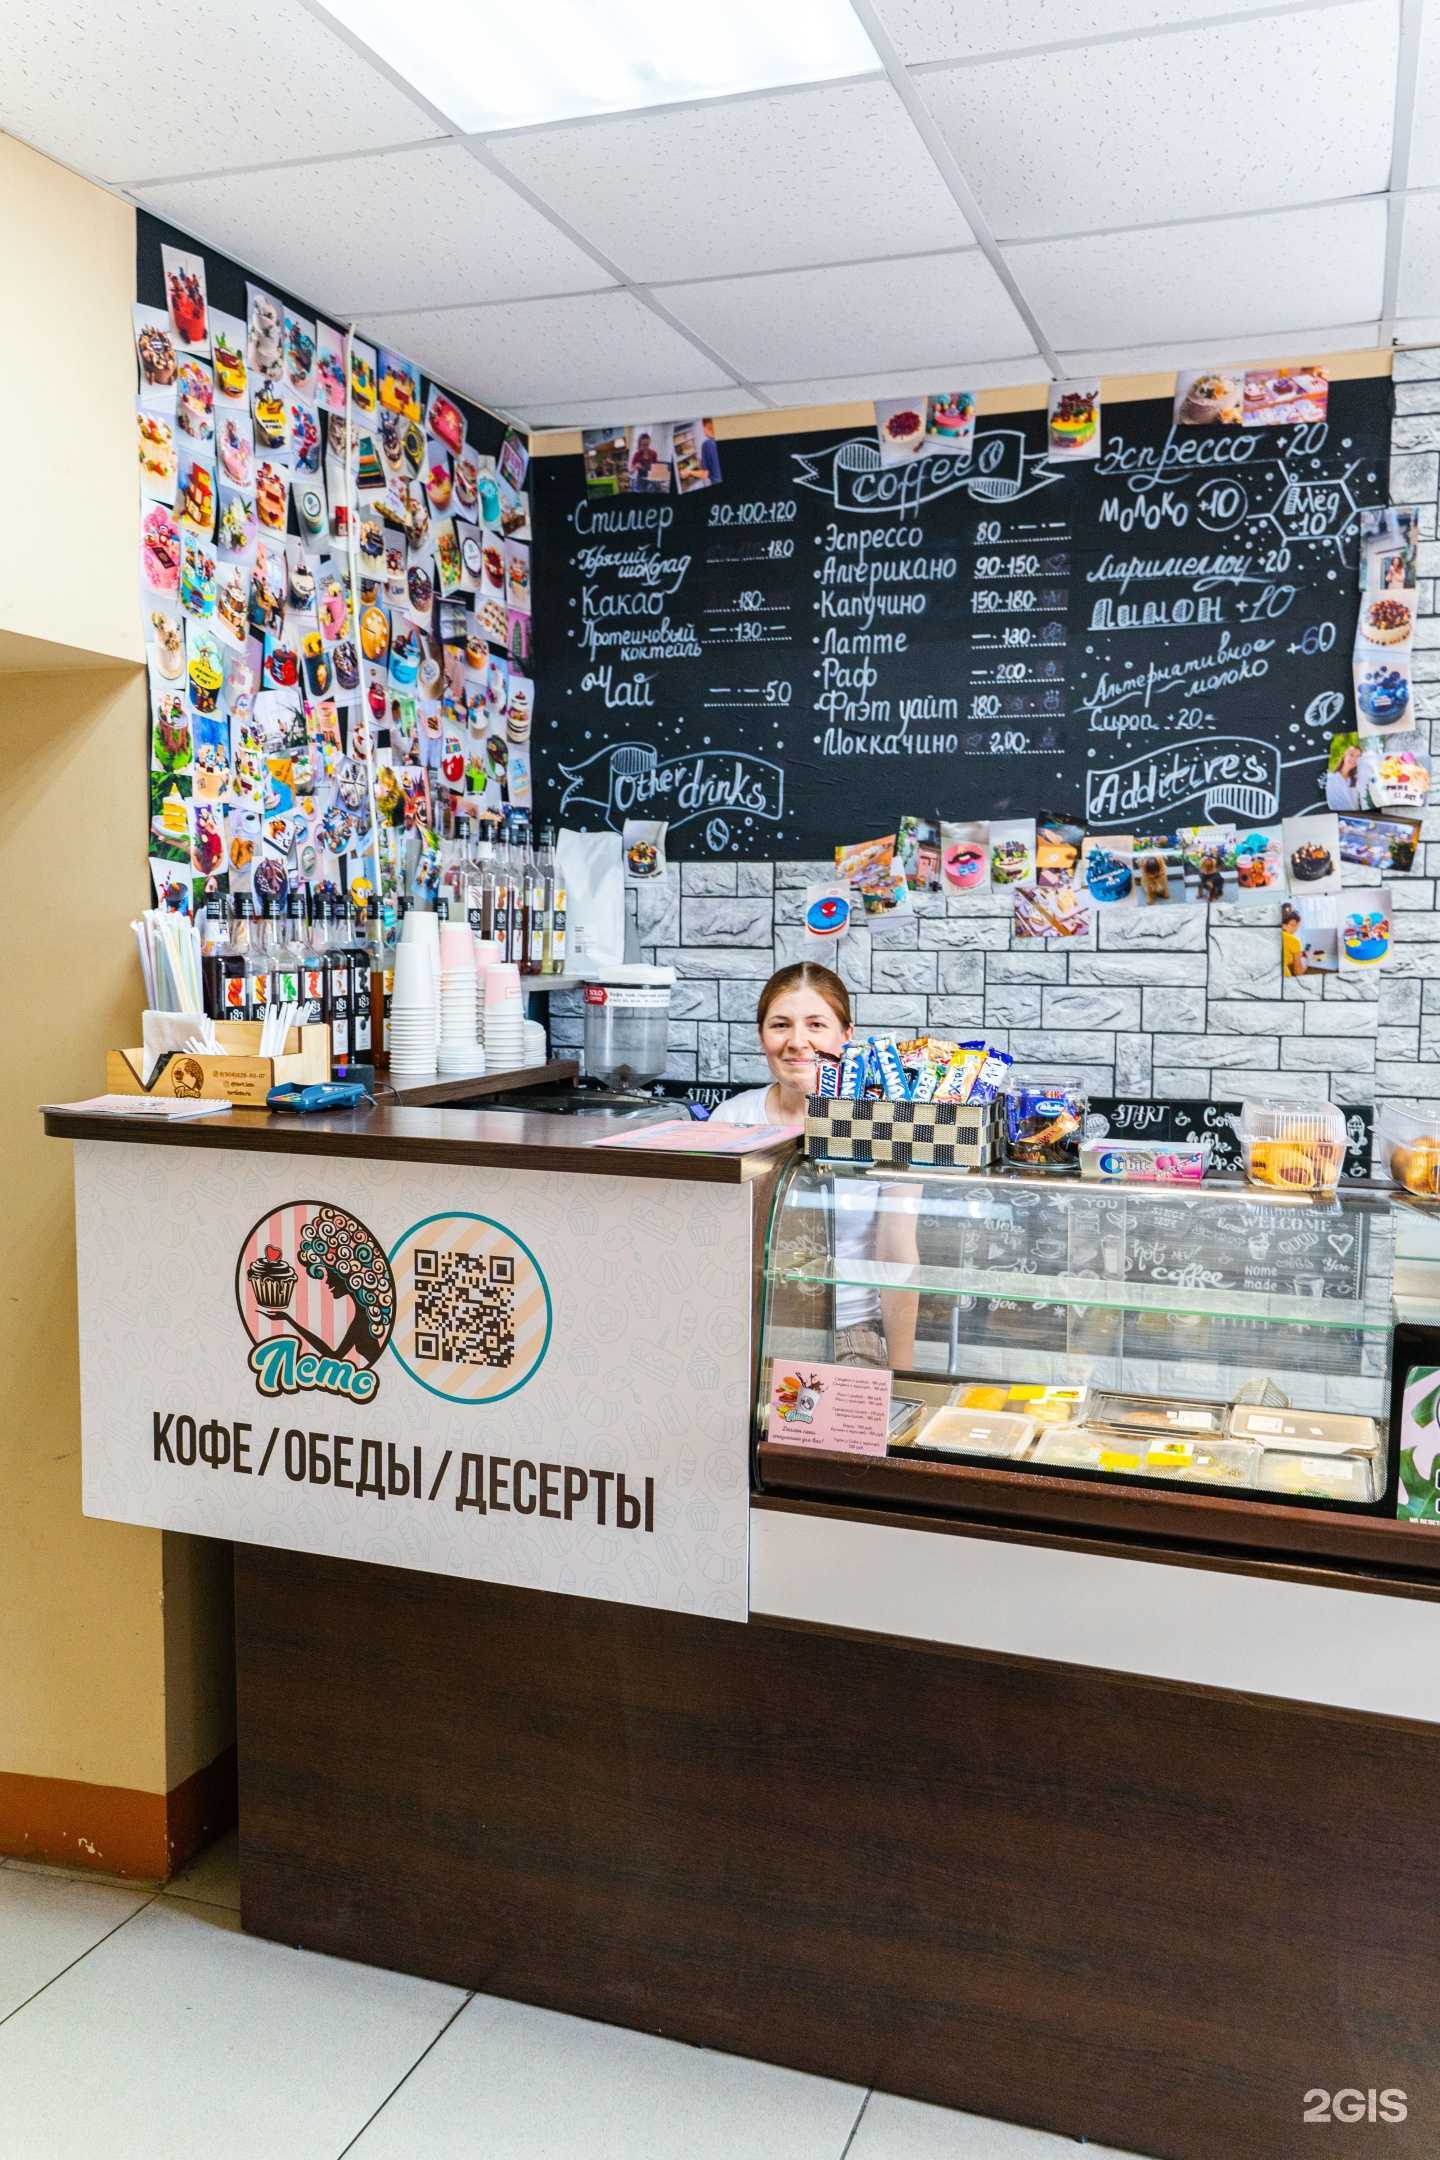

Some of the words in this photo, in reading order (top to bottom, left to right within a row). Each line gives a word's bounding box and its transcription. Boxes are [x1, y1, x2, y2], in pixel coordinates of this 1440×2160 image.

[1095, 426, 1262, 492] Эспрессо
[1100, 491, 1188, 532] Молоко
[825, 523, 923, 563] Эспрессо
[976, 521, 1001, 543] 80
[820, 556, 957, 598] Американо
[582, 585, 664, 616] Какао
[820, 590, 926, 630] Капучино
[621, 643, 702, 661] коктейль
[820, 627, 908, 654] Латте
[581, 665, 658, 708] Чай
[822, 656, 878, 700] Раф
[996, 663, 1026, 681] 200
[1184, 659, 1269, 698] молоко
[818, 689, 890, 723] Флэт
[1090, 707, 1155, 740] Сироп
[822, 727, 958, 755] Моккачино
[614, 766, 687, 812] Other
[678, 759, 766, 812] drinks
[1089, 753, 1268, 815] Additives
[250, 1336, 376, 1401] Лето
